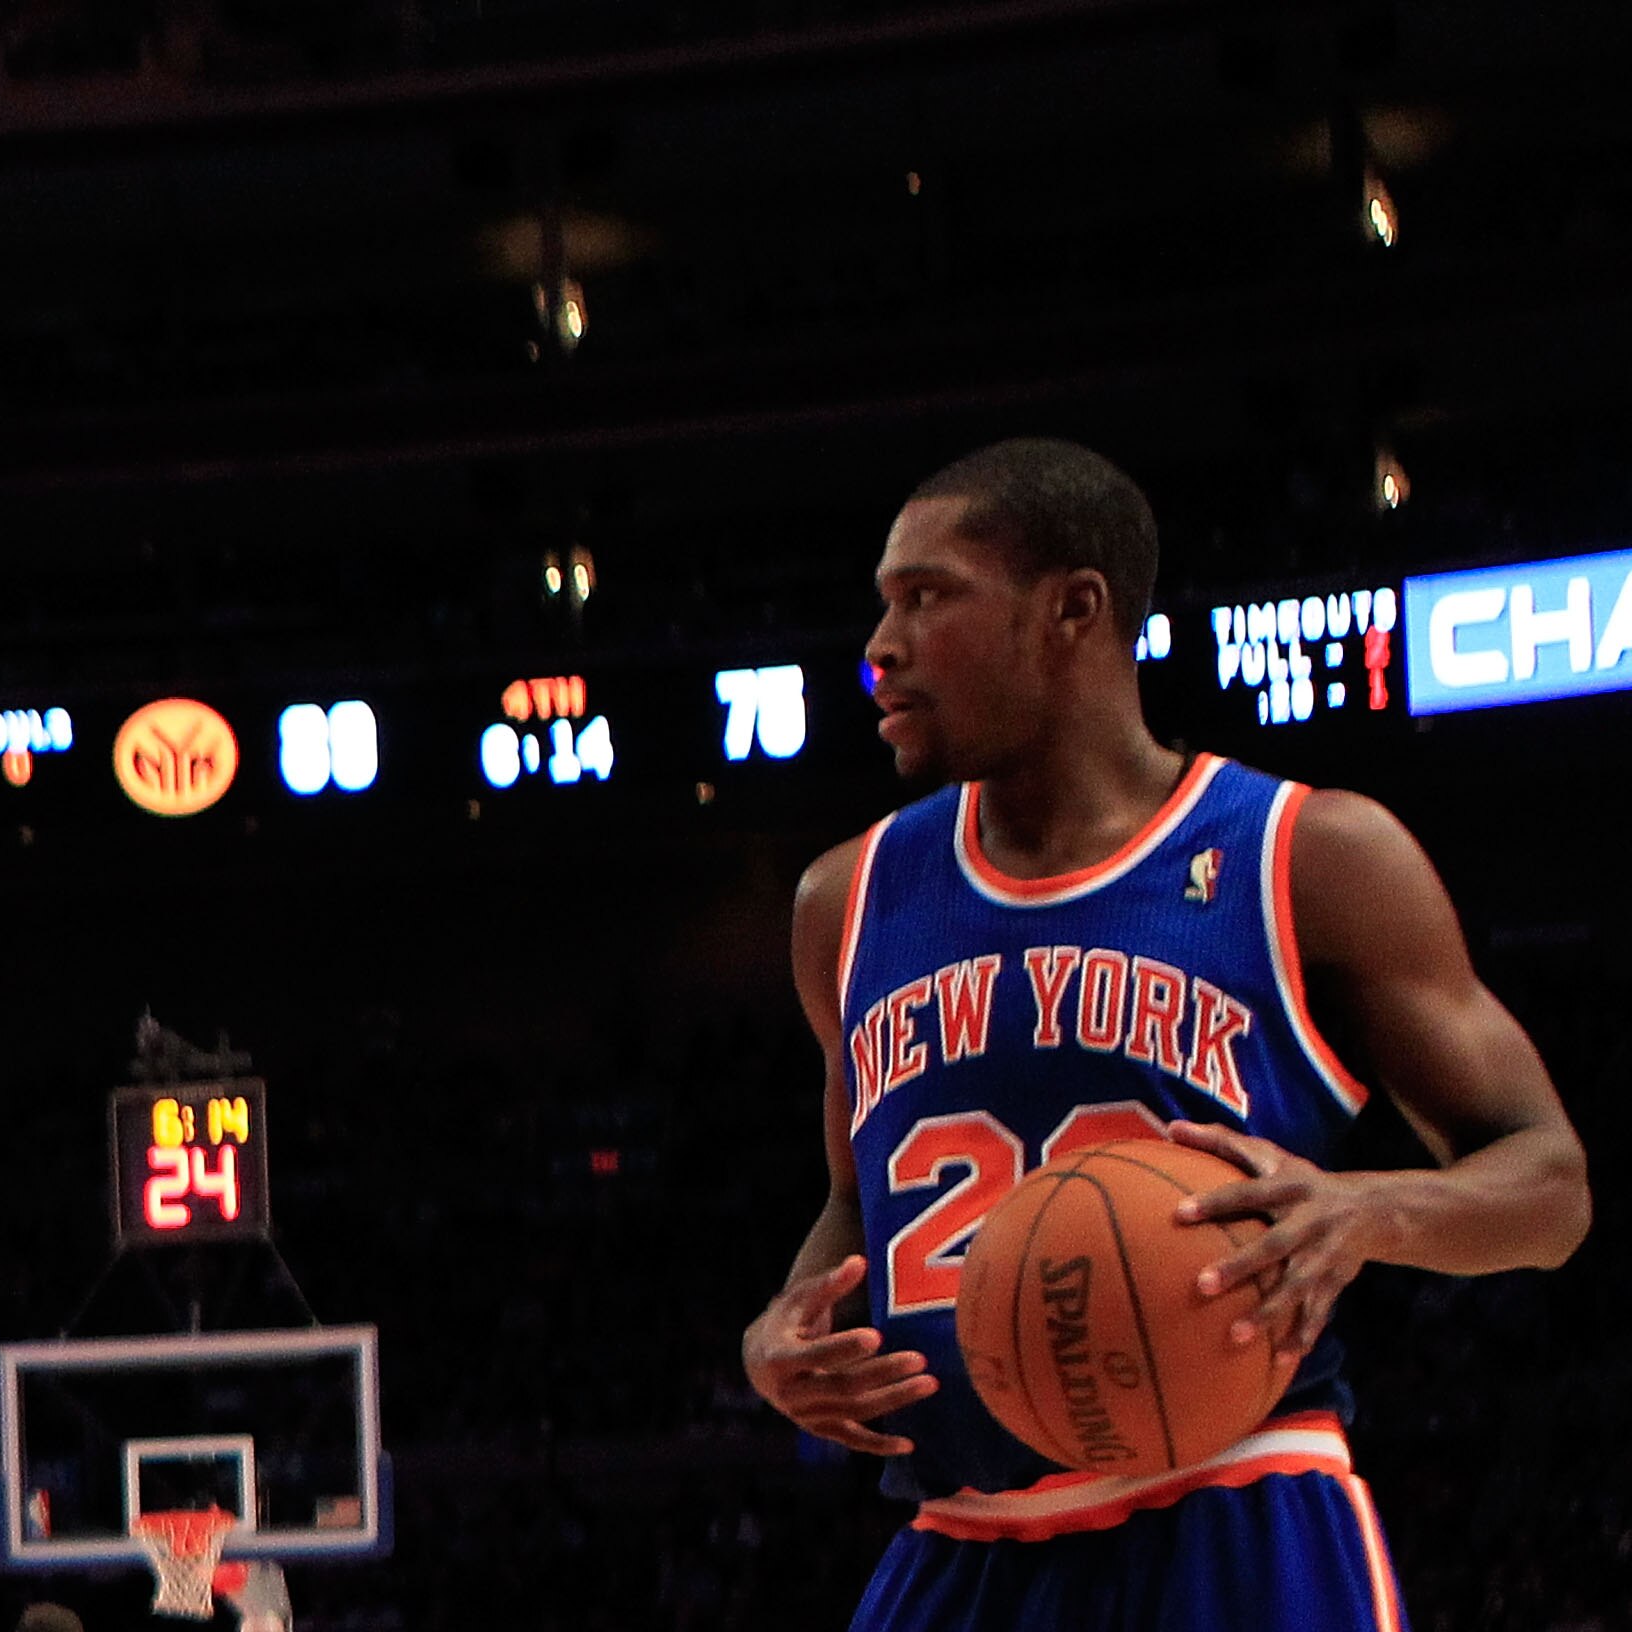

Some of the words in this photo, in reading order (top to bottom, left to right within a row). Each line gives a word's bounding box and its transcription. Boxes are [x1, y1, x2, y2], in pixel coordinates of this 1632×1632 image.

[1211, 587, 1397, 648] TIMEOUTS
[850, 952, 1002, 1141] NEW
[1024, 945, 1252, 1119] YORK
[143, 1143, 241, 1230] 24
[152, 1096, 250, 1147] 6:14
[887, 1100, 1178, 1318] 2
[1039, 1254, 1139, 1462] SPALDING
